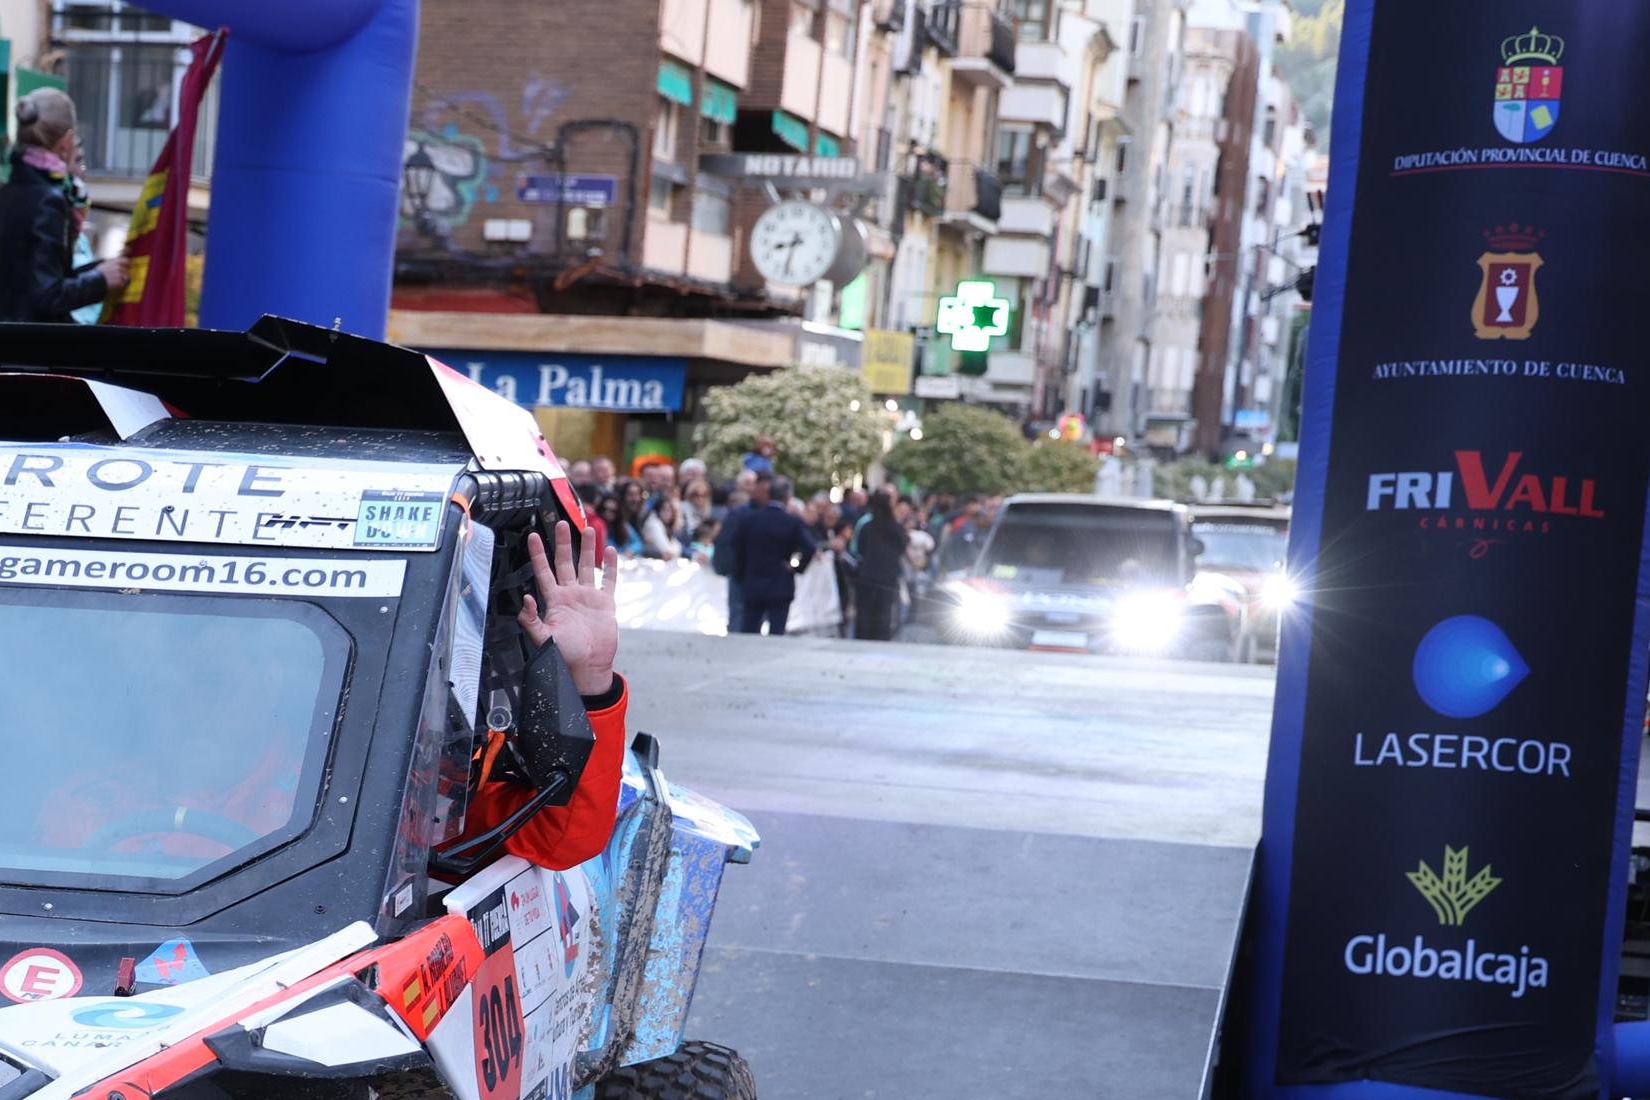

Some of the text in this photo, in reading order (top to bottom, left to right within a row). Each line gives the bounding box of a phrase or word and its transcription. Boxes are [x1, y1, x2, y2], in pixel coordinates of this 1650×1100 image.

[1394, 147, 1647, 170] DIPUTACIÓN PROVINCIAL DE CUENCA
[537, 364, 665, 409] Palma
[1372, 359, 1626, 384] AYUNTAMIENTO DE CUENCA
[365, 505, 433, 521] SHAKE
[365, 522, 429, 538] DO
[1353, 732, 1572, 777] LASERCOR
[20, 964, 61, 995] E
[1344, 935, 1549, 998] Globalcaja
[478, 975, 522, 1092] 304
